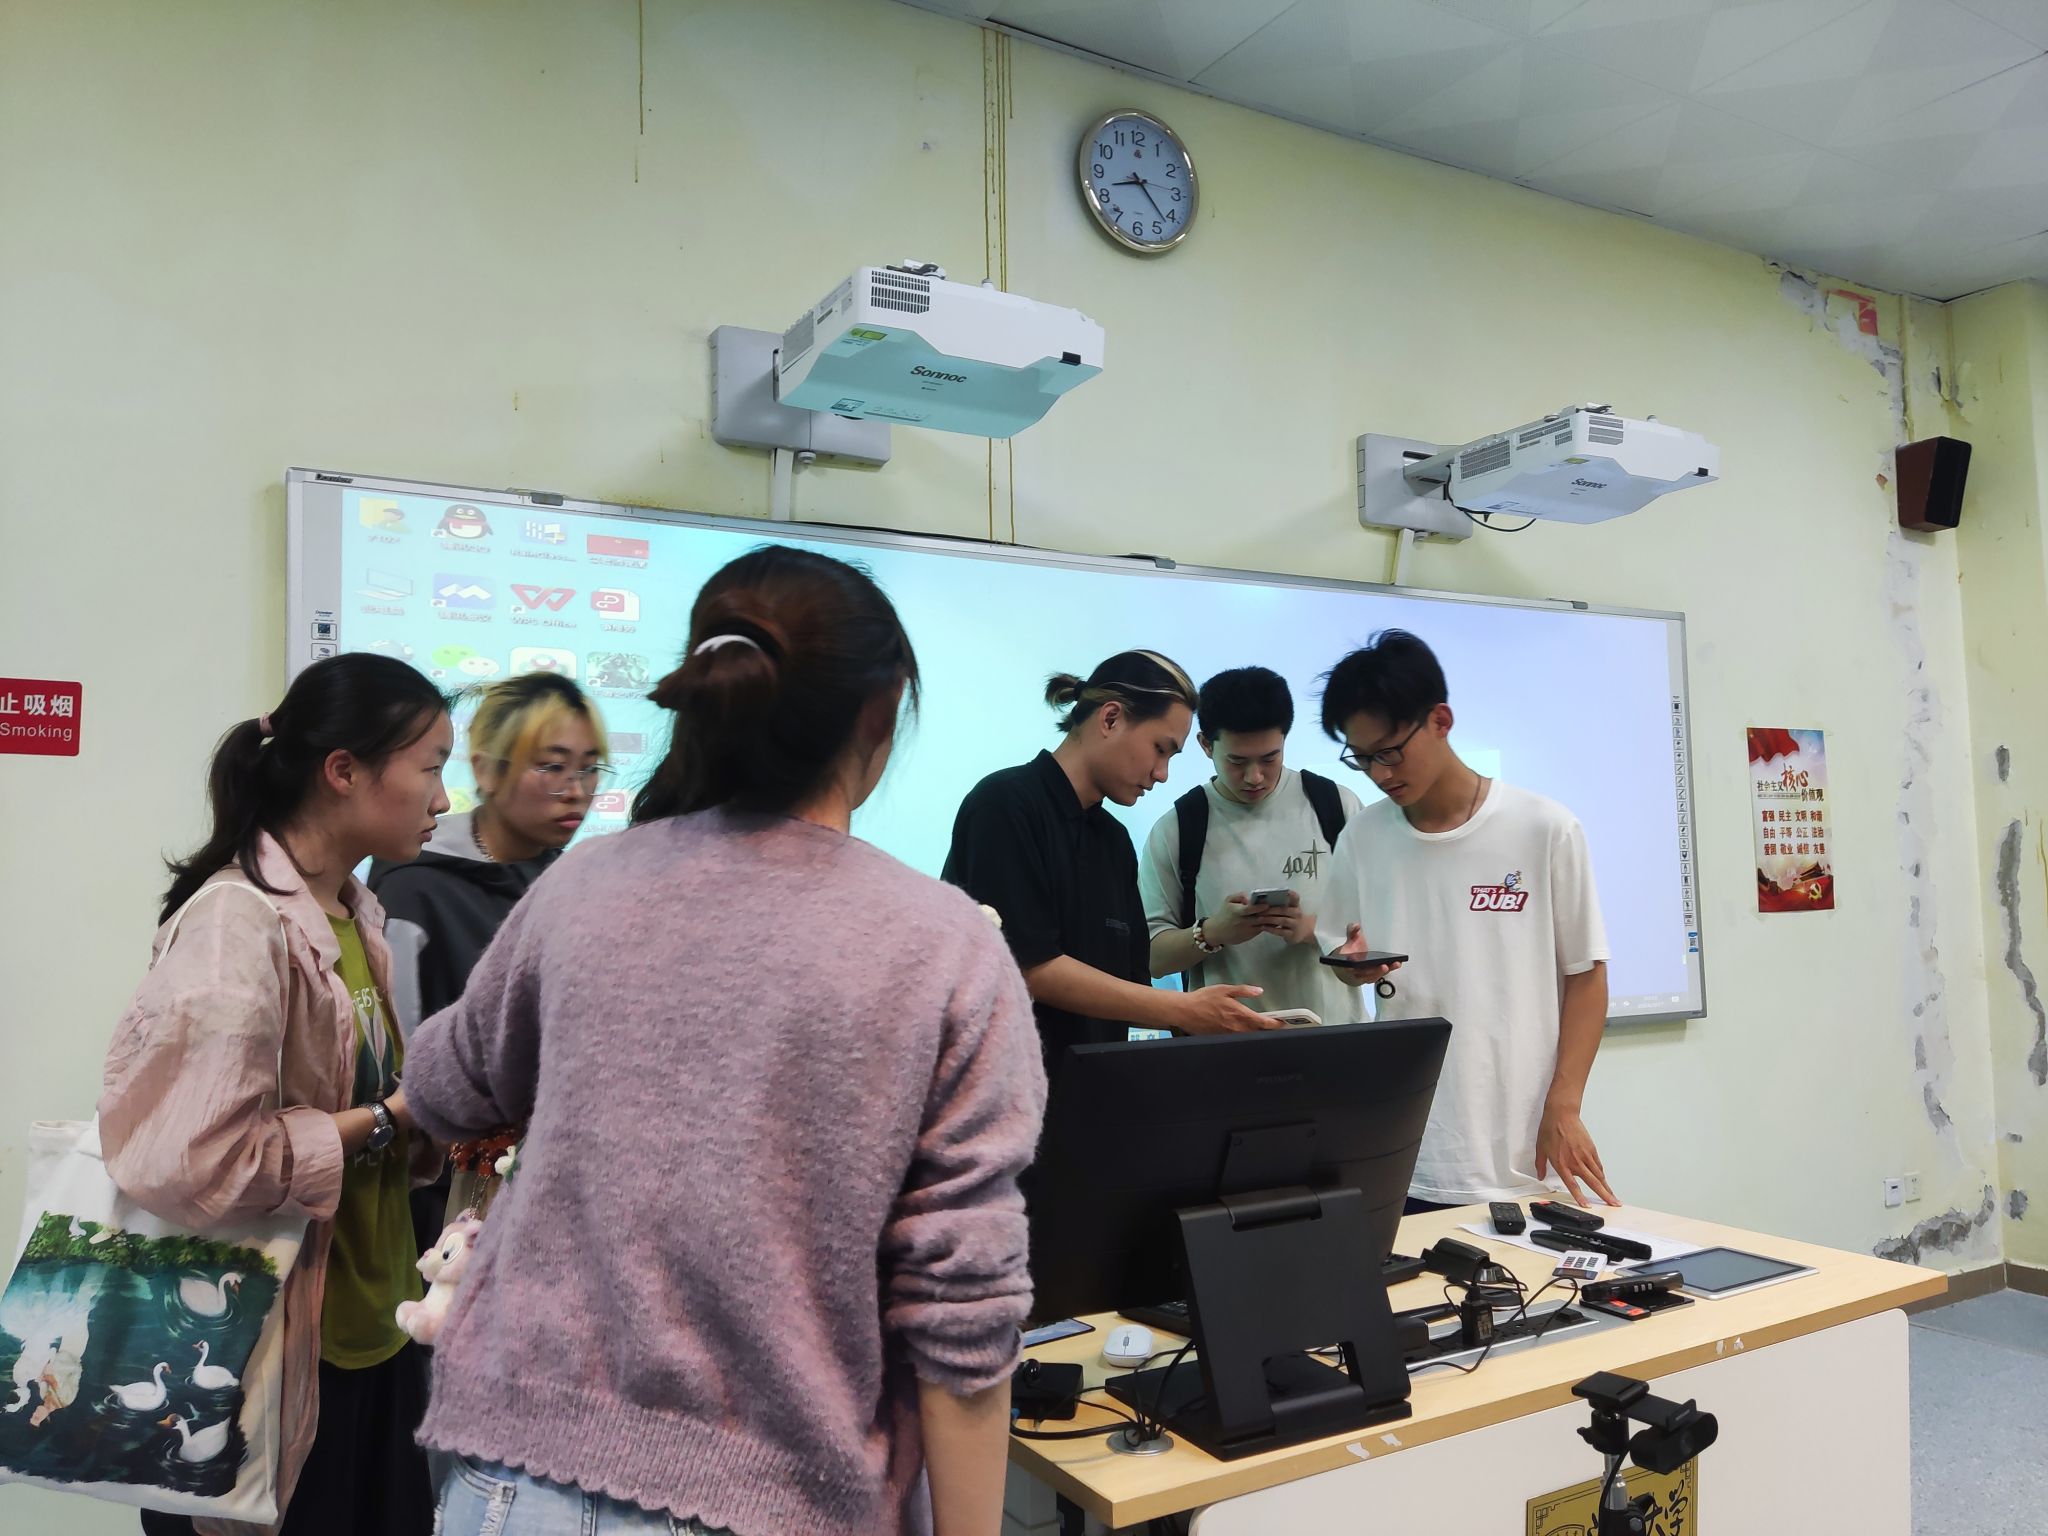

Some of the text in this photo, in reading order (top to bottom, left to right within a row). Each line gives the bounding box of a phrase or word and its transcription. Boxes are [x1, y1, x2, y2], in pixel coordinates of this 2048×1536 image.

[1113, 130, 1125, 147] 11
[1131, 130, 1146, 147] 12
[1099, 143, 1113, 160] 10
[1093, 163, 1104, 179] 9
[1165, 163, 1176, 179] 2
[1099, 188, 1110, 203] 8
[1170, 187, 1181, 202] 3
[1112, 211, 1124, 223] 7
[1166, 208, 1176, 223] 4
[1132, 221, 1143, 236] 6
[1152, 221, 1163, 235] 5
[910, 365, 967, 383] Sonnoc
[0, 692, 74, 718] 止吸烟
[0, 722, 73, 741] Smoking
[1780, 763, 1809, 792] 核心
[1778, 809, 1792, 822] 民主
[1763, 827, 1776, 839] 自由
[1472, 893, 1524, 910] DUB!
